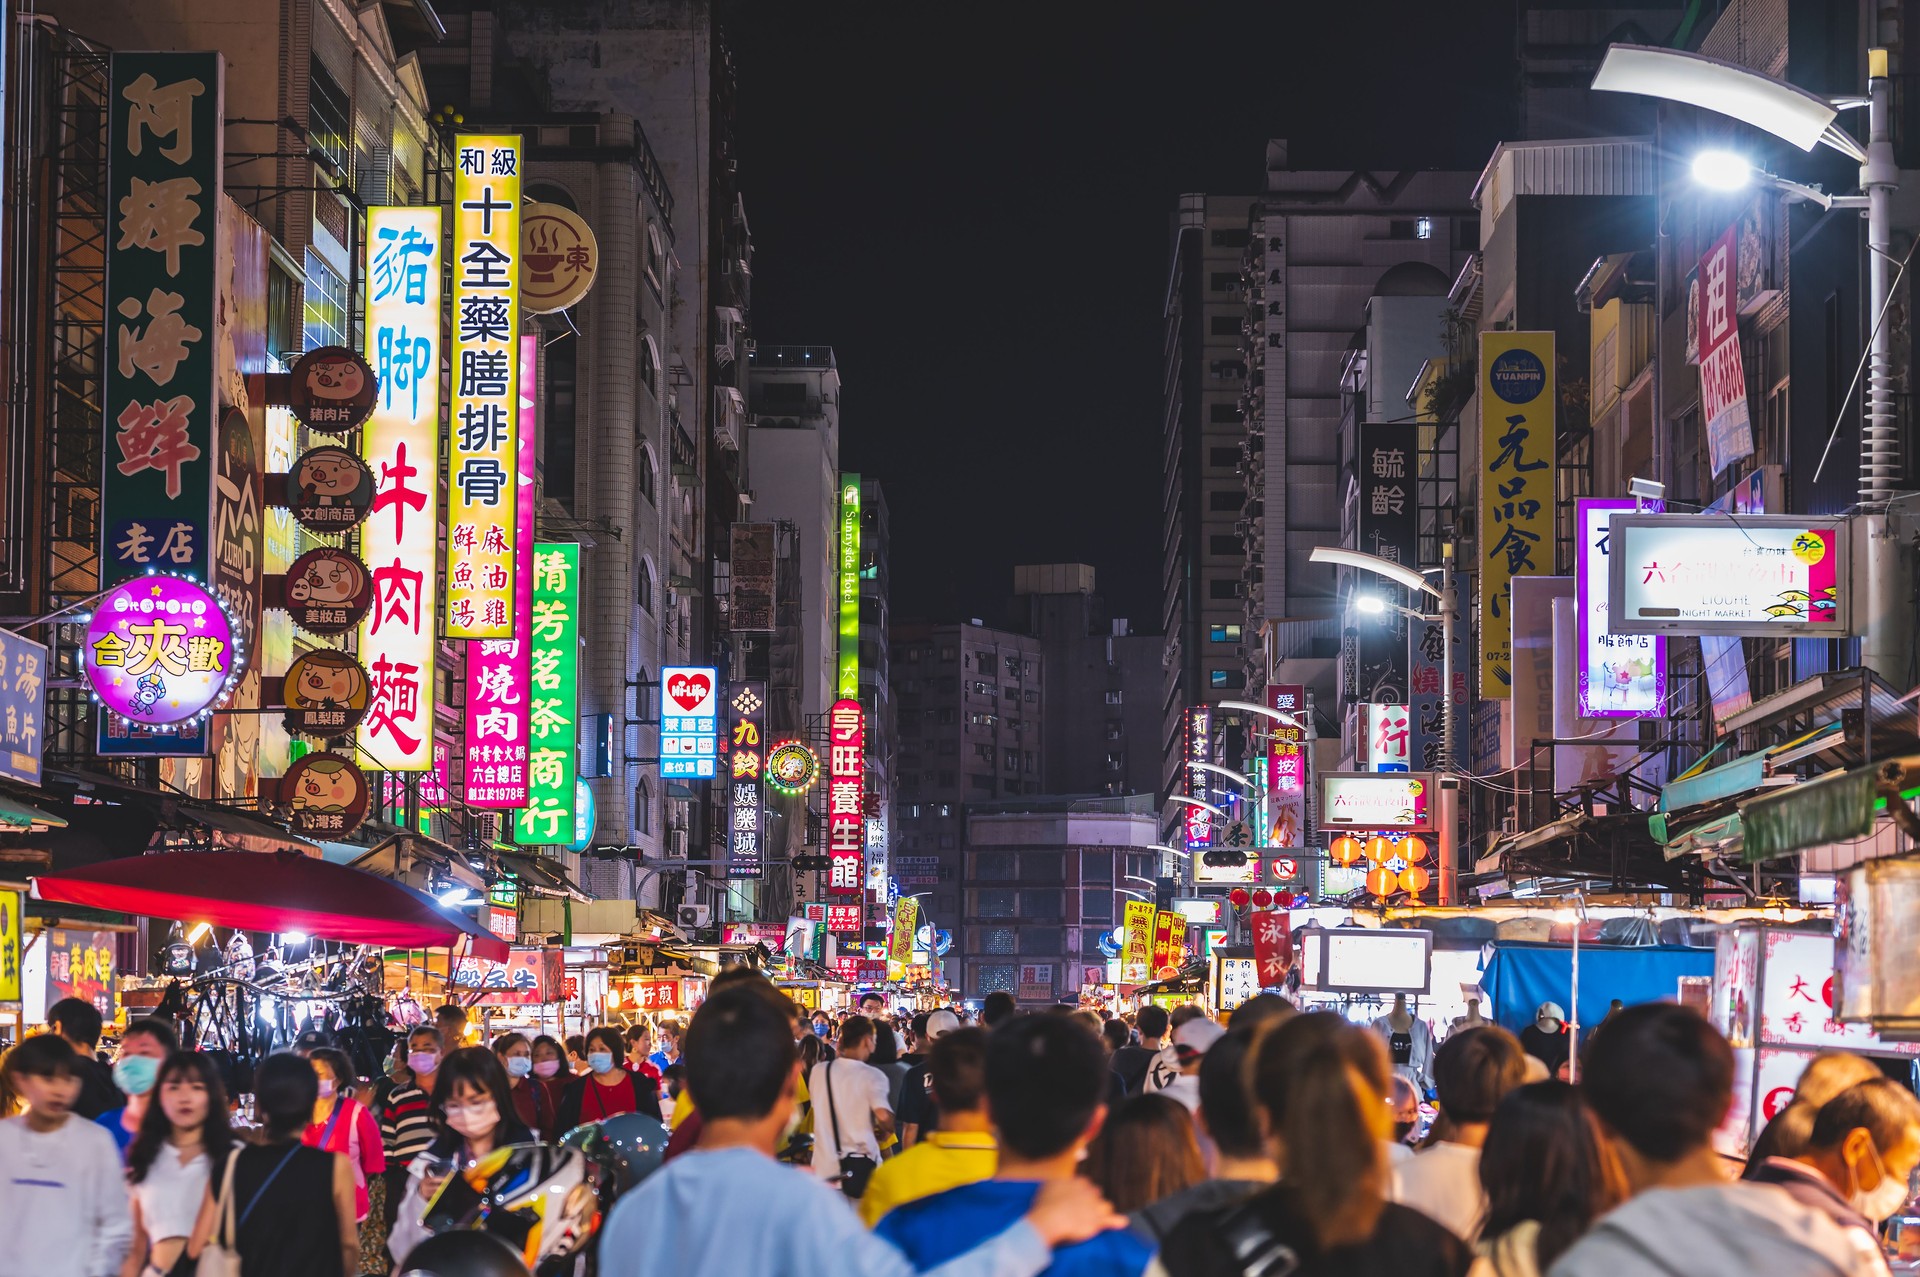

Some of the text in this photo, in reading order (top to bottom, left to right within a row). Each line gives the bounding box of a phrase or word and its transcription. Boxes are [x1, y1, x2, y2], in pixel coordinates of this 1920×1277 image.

[459, 148, 517, 176] 和級
[564, 245, 592, 273] 東
[1706, 244, 1728, 346] 租
[457, 187, 513, 506] 十全藥膳排骨
[1495, 372, 1541, 381] YUANPIN
[310, 407, 351, 422] 豬肉片
[1372, 448, 1405, 515] 毓齡
[301, 507, 356, 522] 文創商品
[116, 522, 195, 565] 老店
[844, 511, 856, 604] Sunnyside Hotel
[450, 524, 477, 629] 鮮魚湯
[480, 524, 511, 628] 麻油雞
[305, 609, 348, 624] 美妝品
[1682, 609, 1711, 618] NIGHT
[671, 681, 707, 702] Hi-Life
[304, 711, 346, 726] 鳳梨酥
[469, 746, 526, 762] 附素食火鍋
[663, 761, 696, 774] 座位區
[473, 765, 522, 783] 六合總店
[733, 718, 760, 855] 九鈴娛樂城
[1277, 759, 1296, 790] 按摩
[468, 787, 525, 801] 創立於1978年
[832, 707, 860, 888] 亨旺養生館
[807, 905, 824, 921] 售
[1259, 919, 1288, 978] 泳衣
[622, 984, 673, 1006] 蚵仔煎
[1789, 974, 1816, 1003] 大
